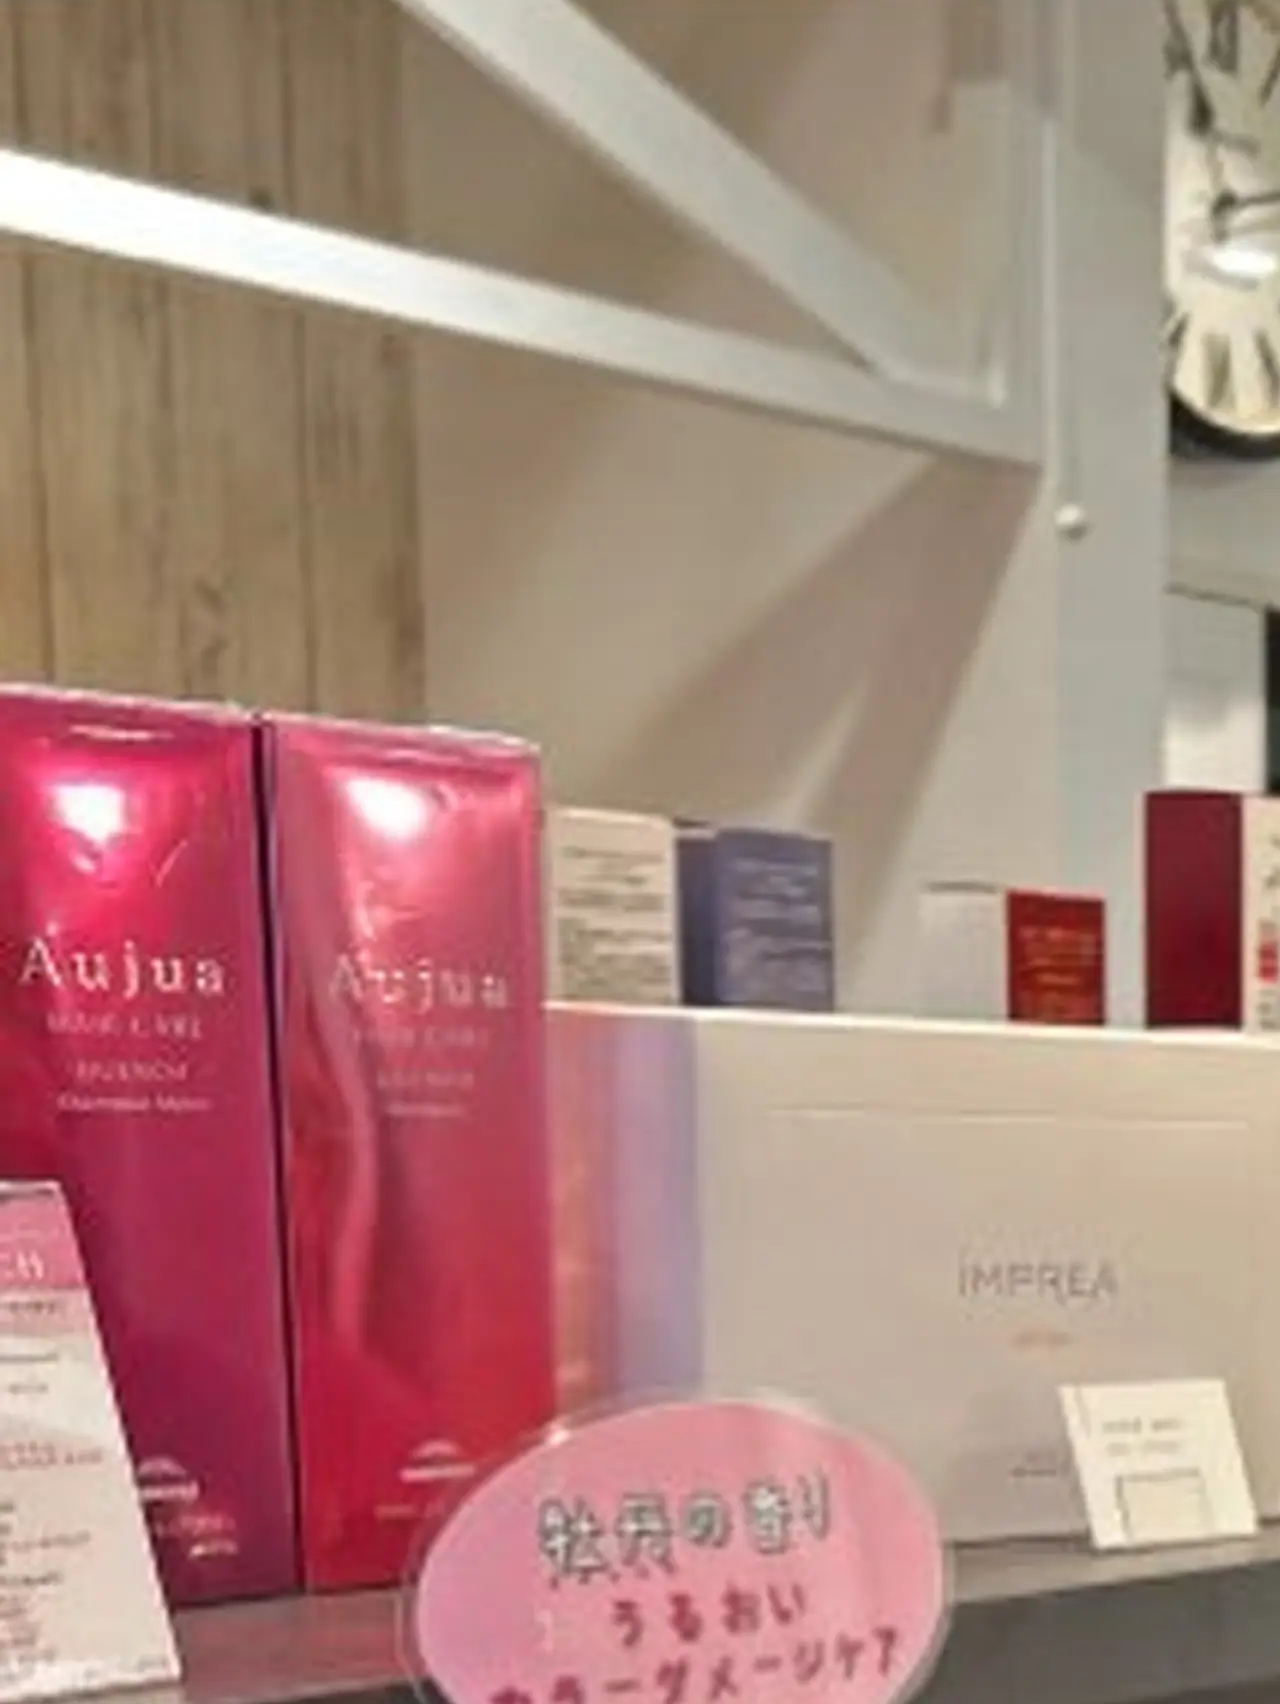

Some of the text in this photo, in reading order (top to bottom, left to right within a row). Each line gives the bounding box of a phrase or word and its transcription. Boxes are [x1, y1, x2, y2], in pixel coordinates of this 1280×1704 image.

[19, 934, 226, 1000] Aujua
[327, 951, 509, 1016] Aujua
[612, 1582, 806, 1648] うるおい
